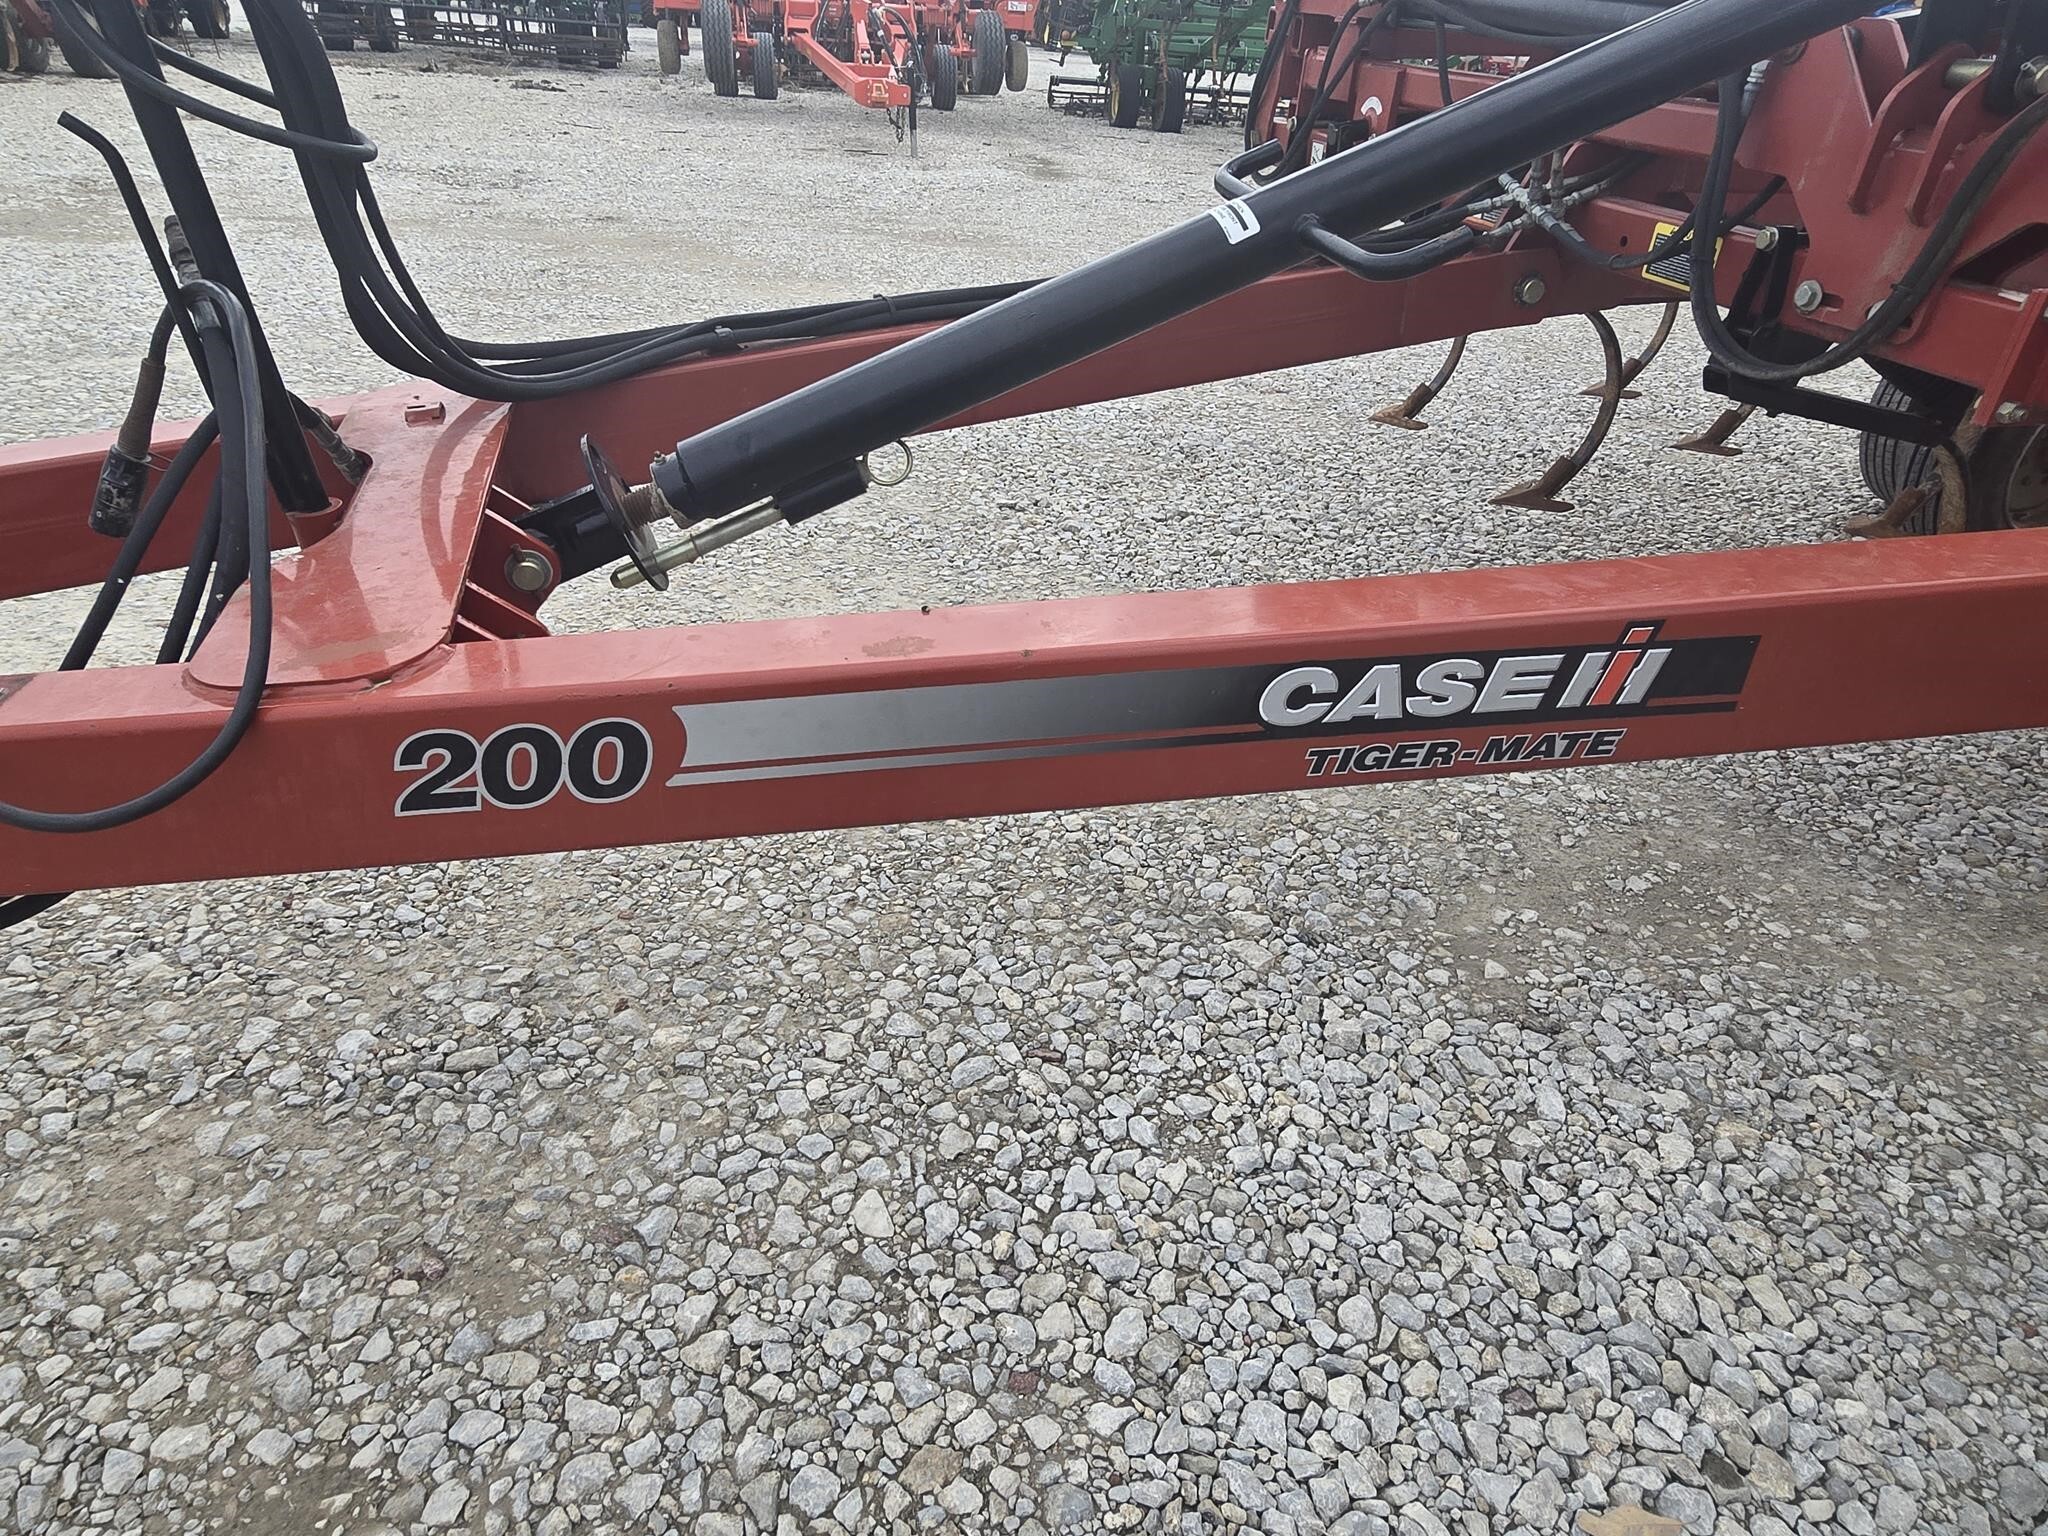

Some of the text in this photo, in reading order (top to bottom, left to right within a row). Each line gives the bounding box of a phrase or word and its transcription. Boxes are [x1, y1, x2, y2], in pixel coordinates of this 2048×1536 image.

[1259, 654, 1566, 726] CASE
[394, 717, 653, 817] 200
[1305, 728, 1628, 777] TIGER-MATE
